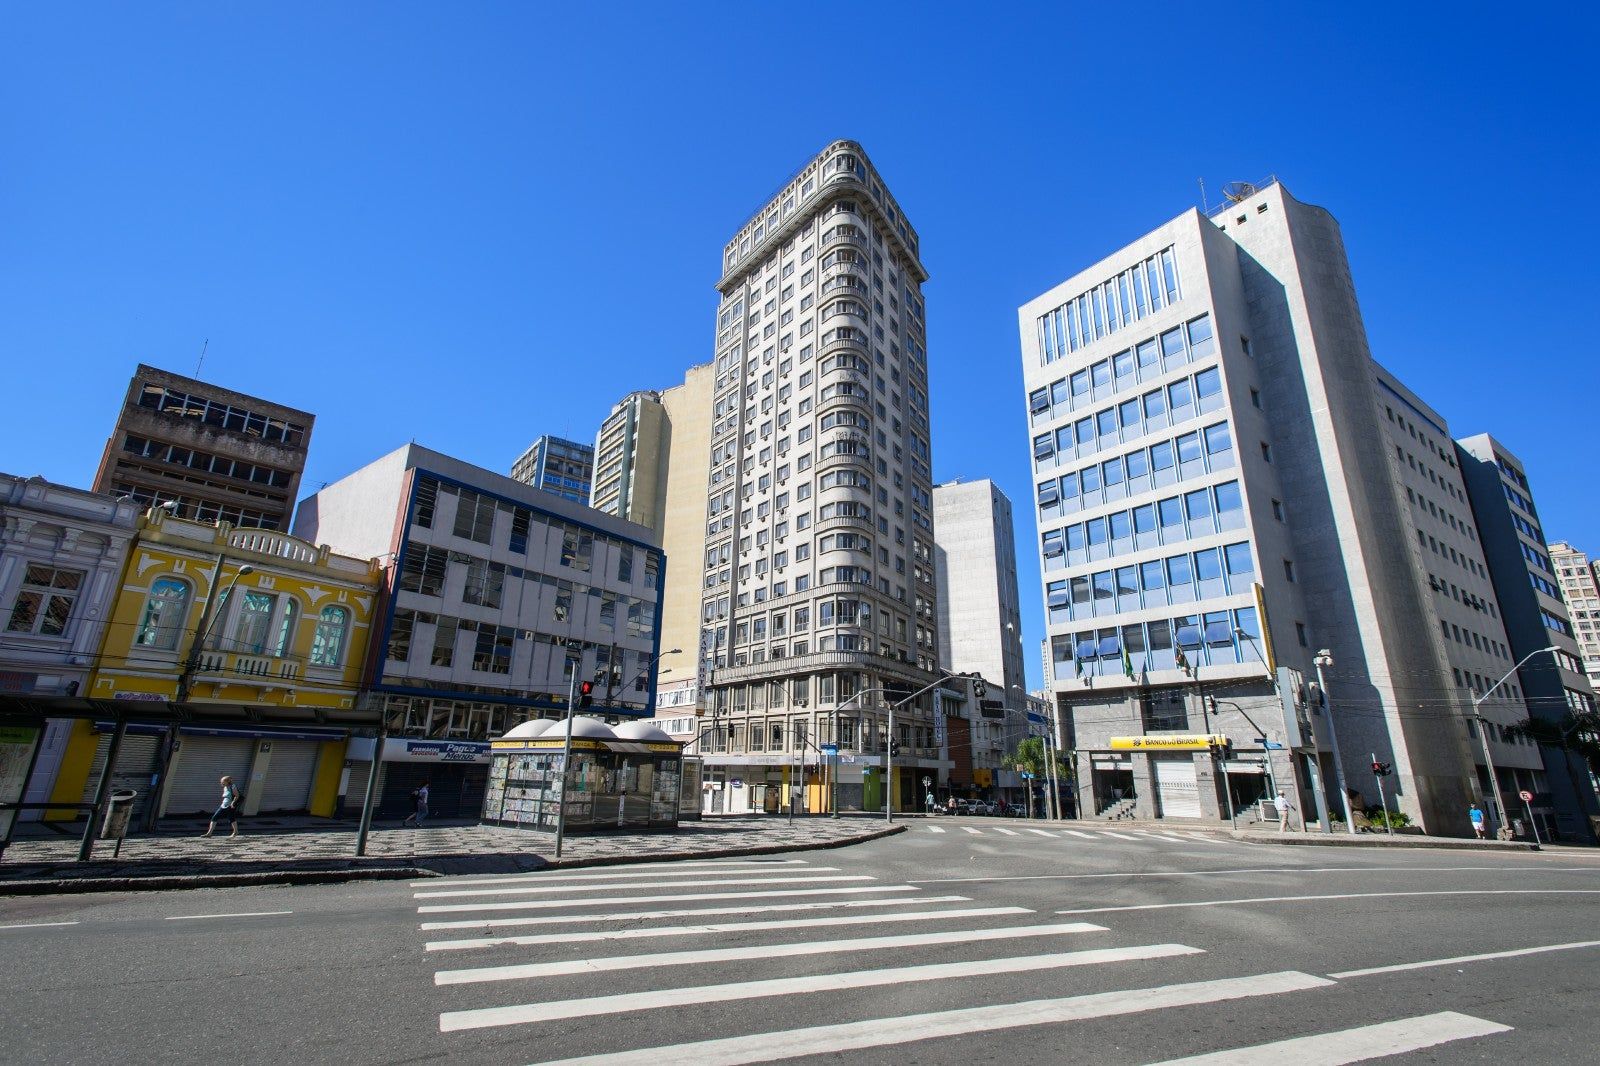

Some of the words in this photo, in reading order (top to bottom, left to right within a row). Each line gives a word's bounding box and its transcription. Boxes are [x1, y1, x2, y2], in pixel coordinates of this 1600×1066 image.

[698, 667, 706, 698] HOTEL
[446, 743, 476, 754] Pague
[443, 752, 475, 760] Menos
